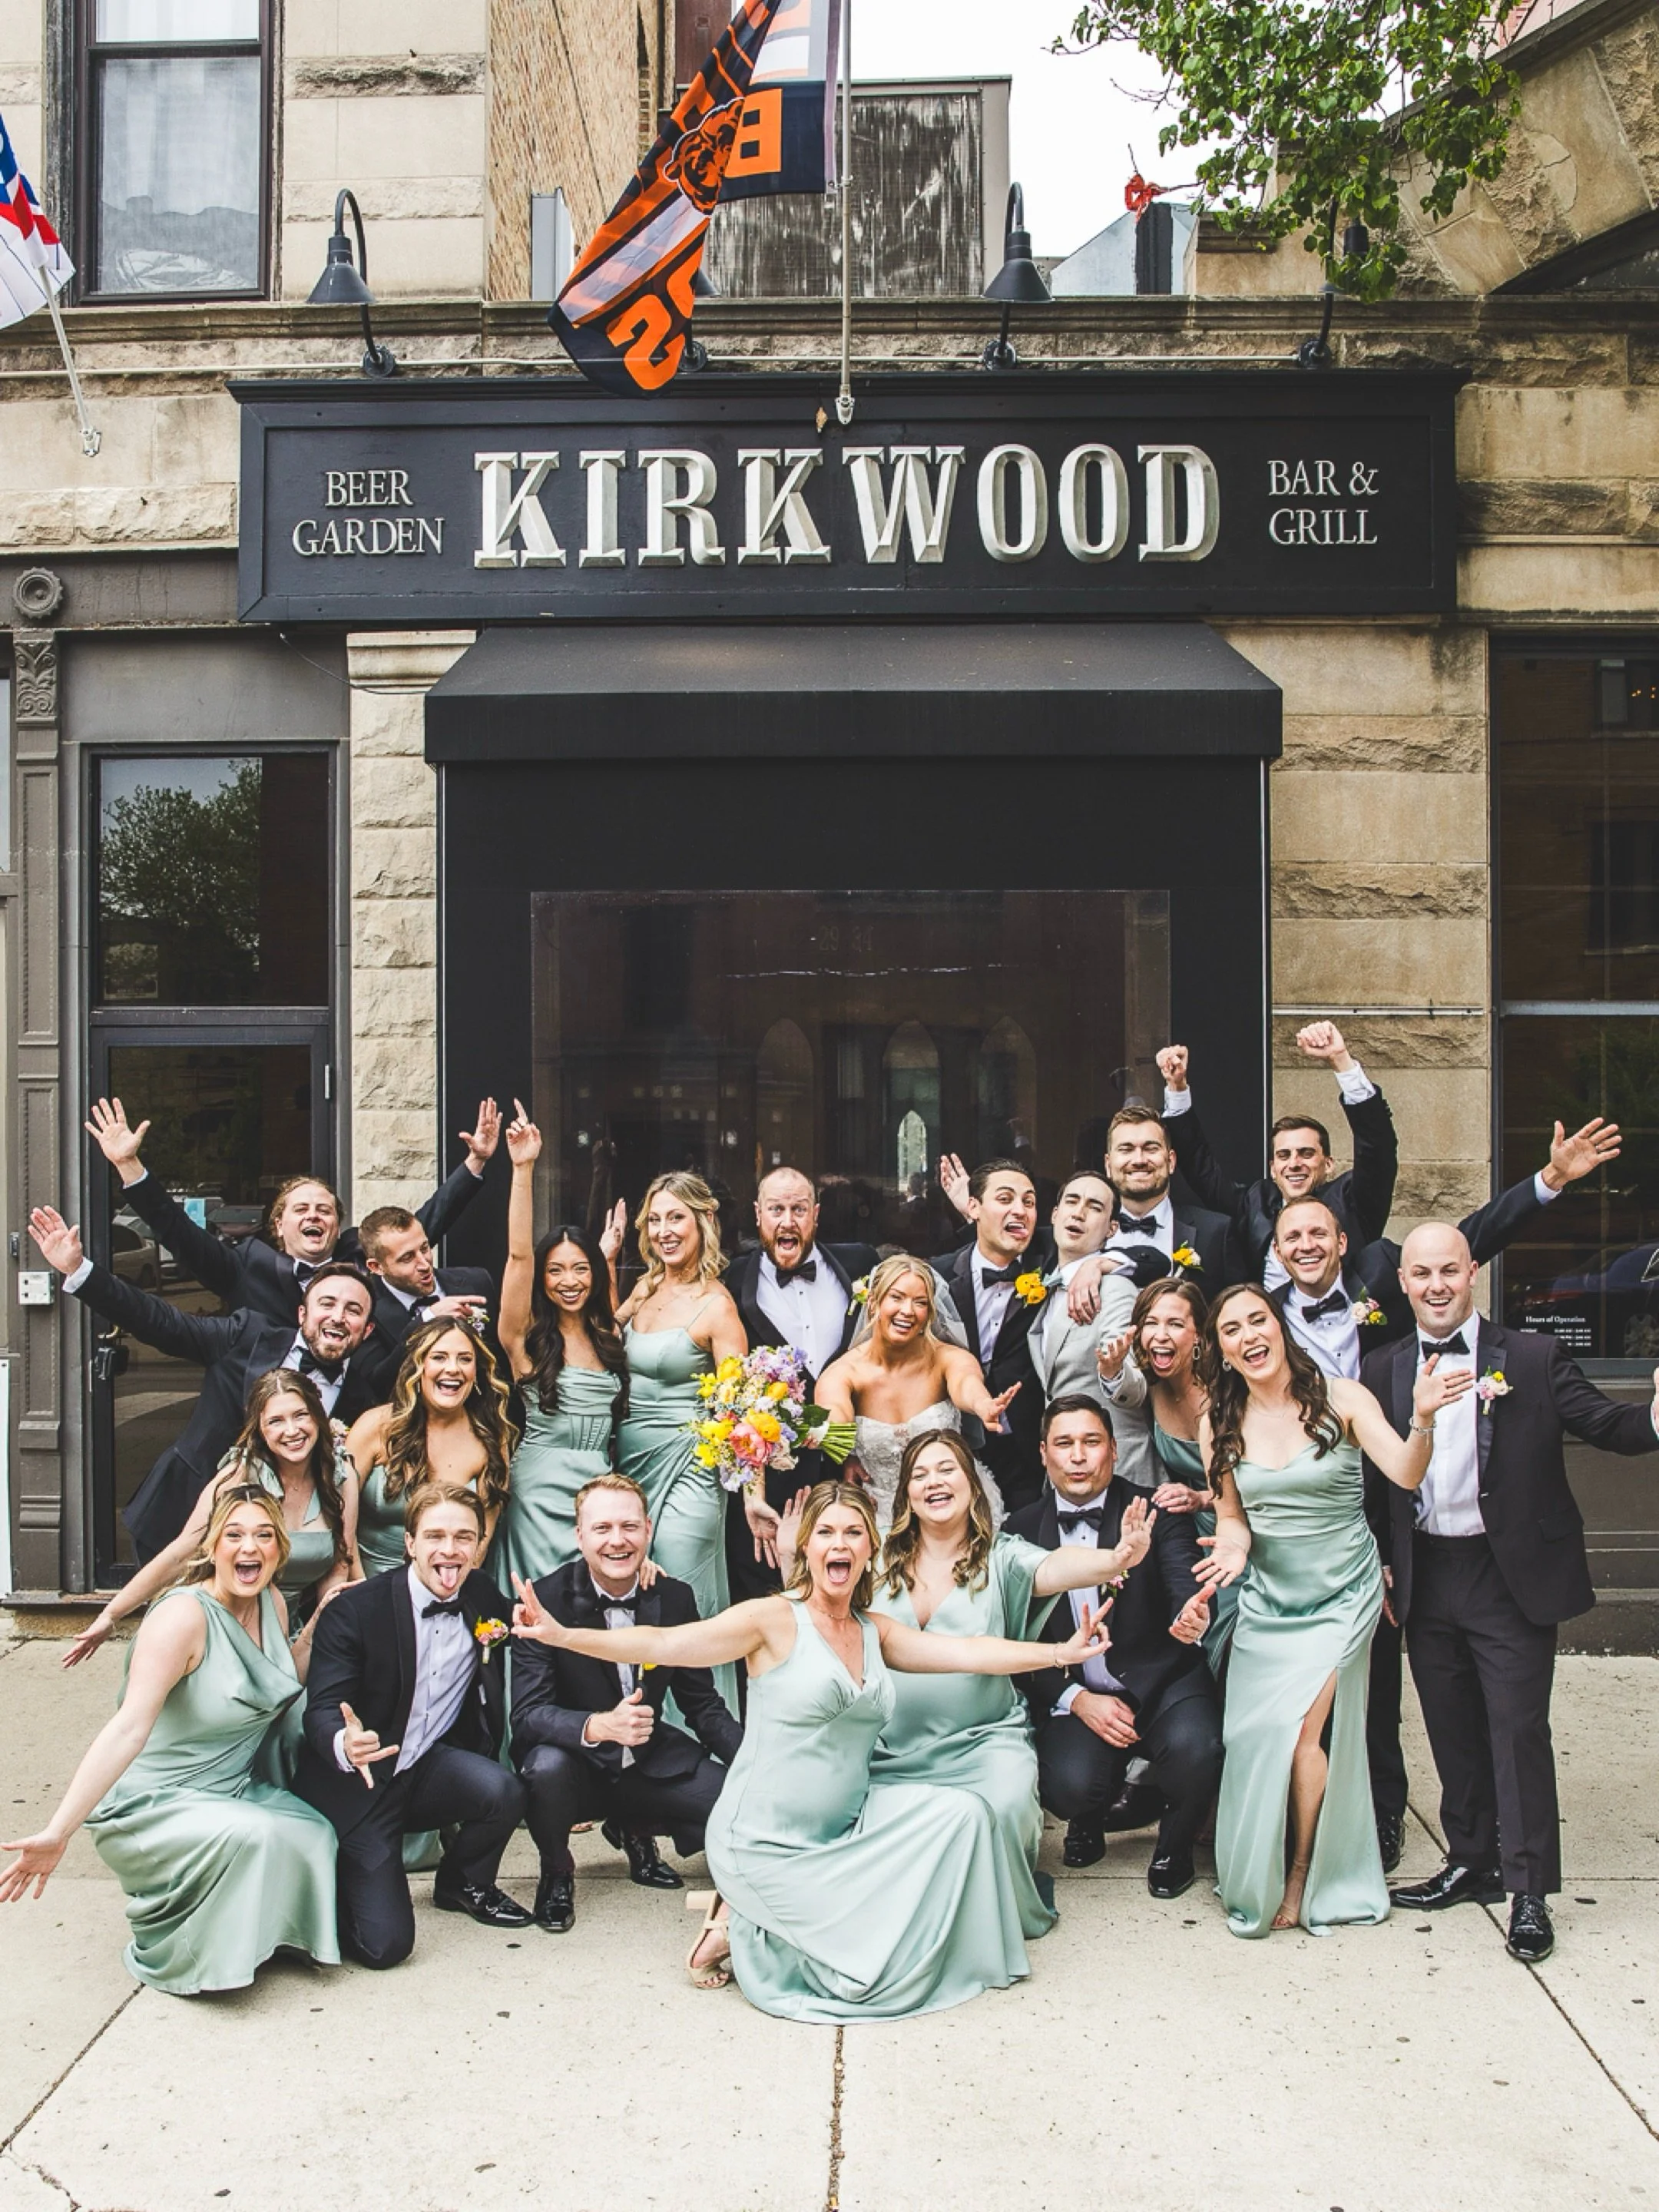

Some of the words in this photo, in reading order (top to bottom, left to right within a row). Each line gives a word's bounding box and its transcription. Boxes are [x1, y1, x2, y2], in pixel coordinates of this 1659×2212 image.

[325, 469, 414, 508] BEER
[1267, 459, 1341, 497] BAR
[1348, 459, 1379, 497] &
[474, 442, 1221, 569] KIRKWOOD
[292, 516, 445, 557] GARDEN
[1268, 508, 1378, 546] GRILL
